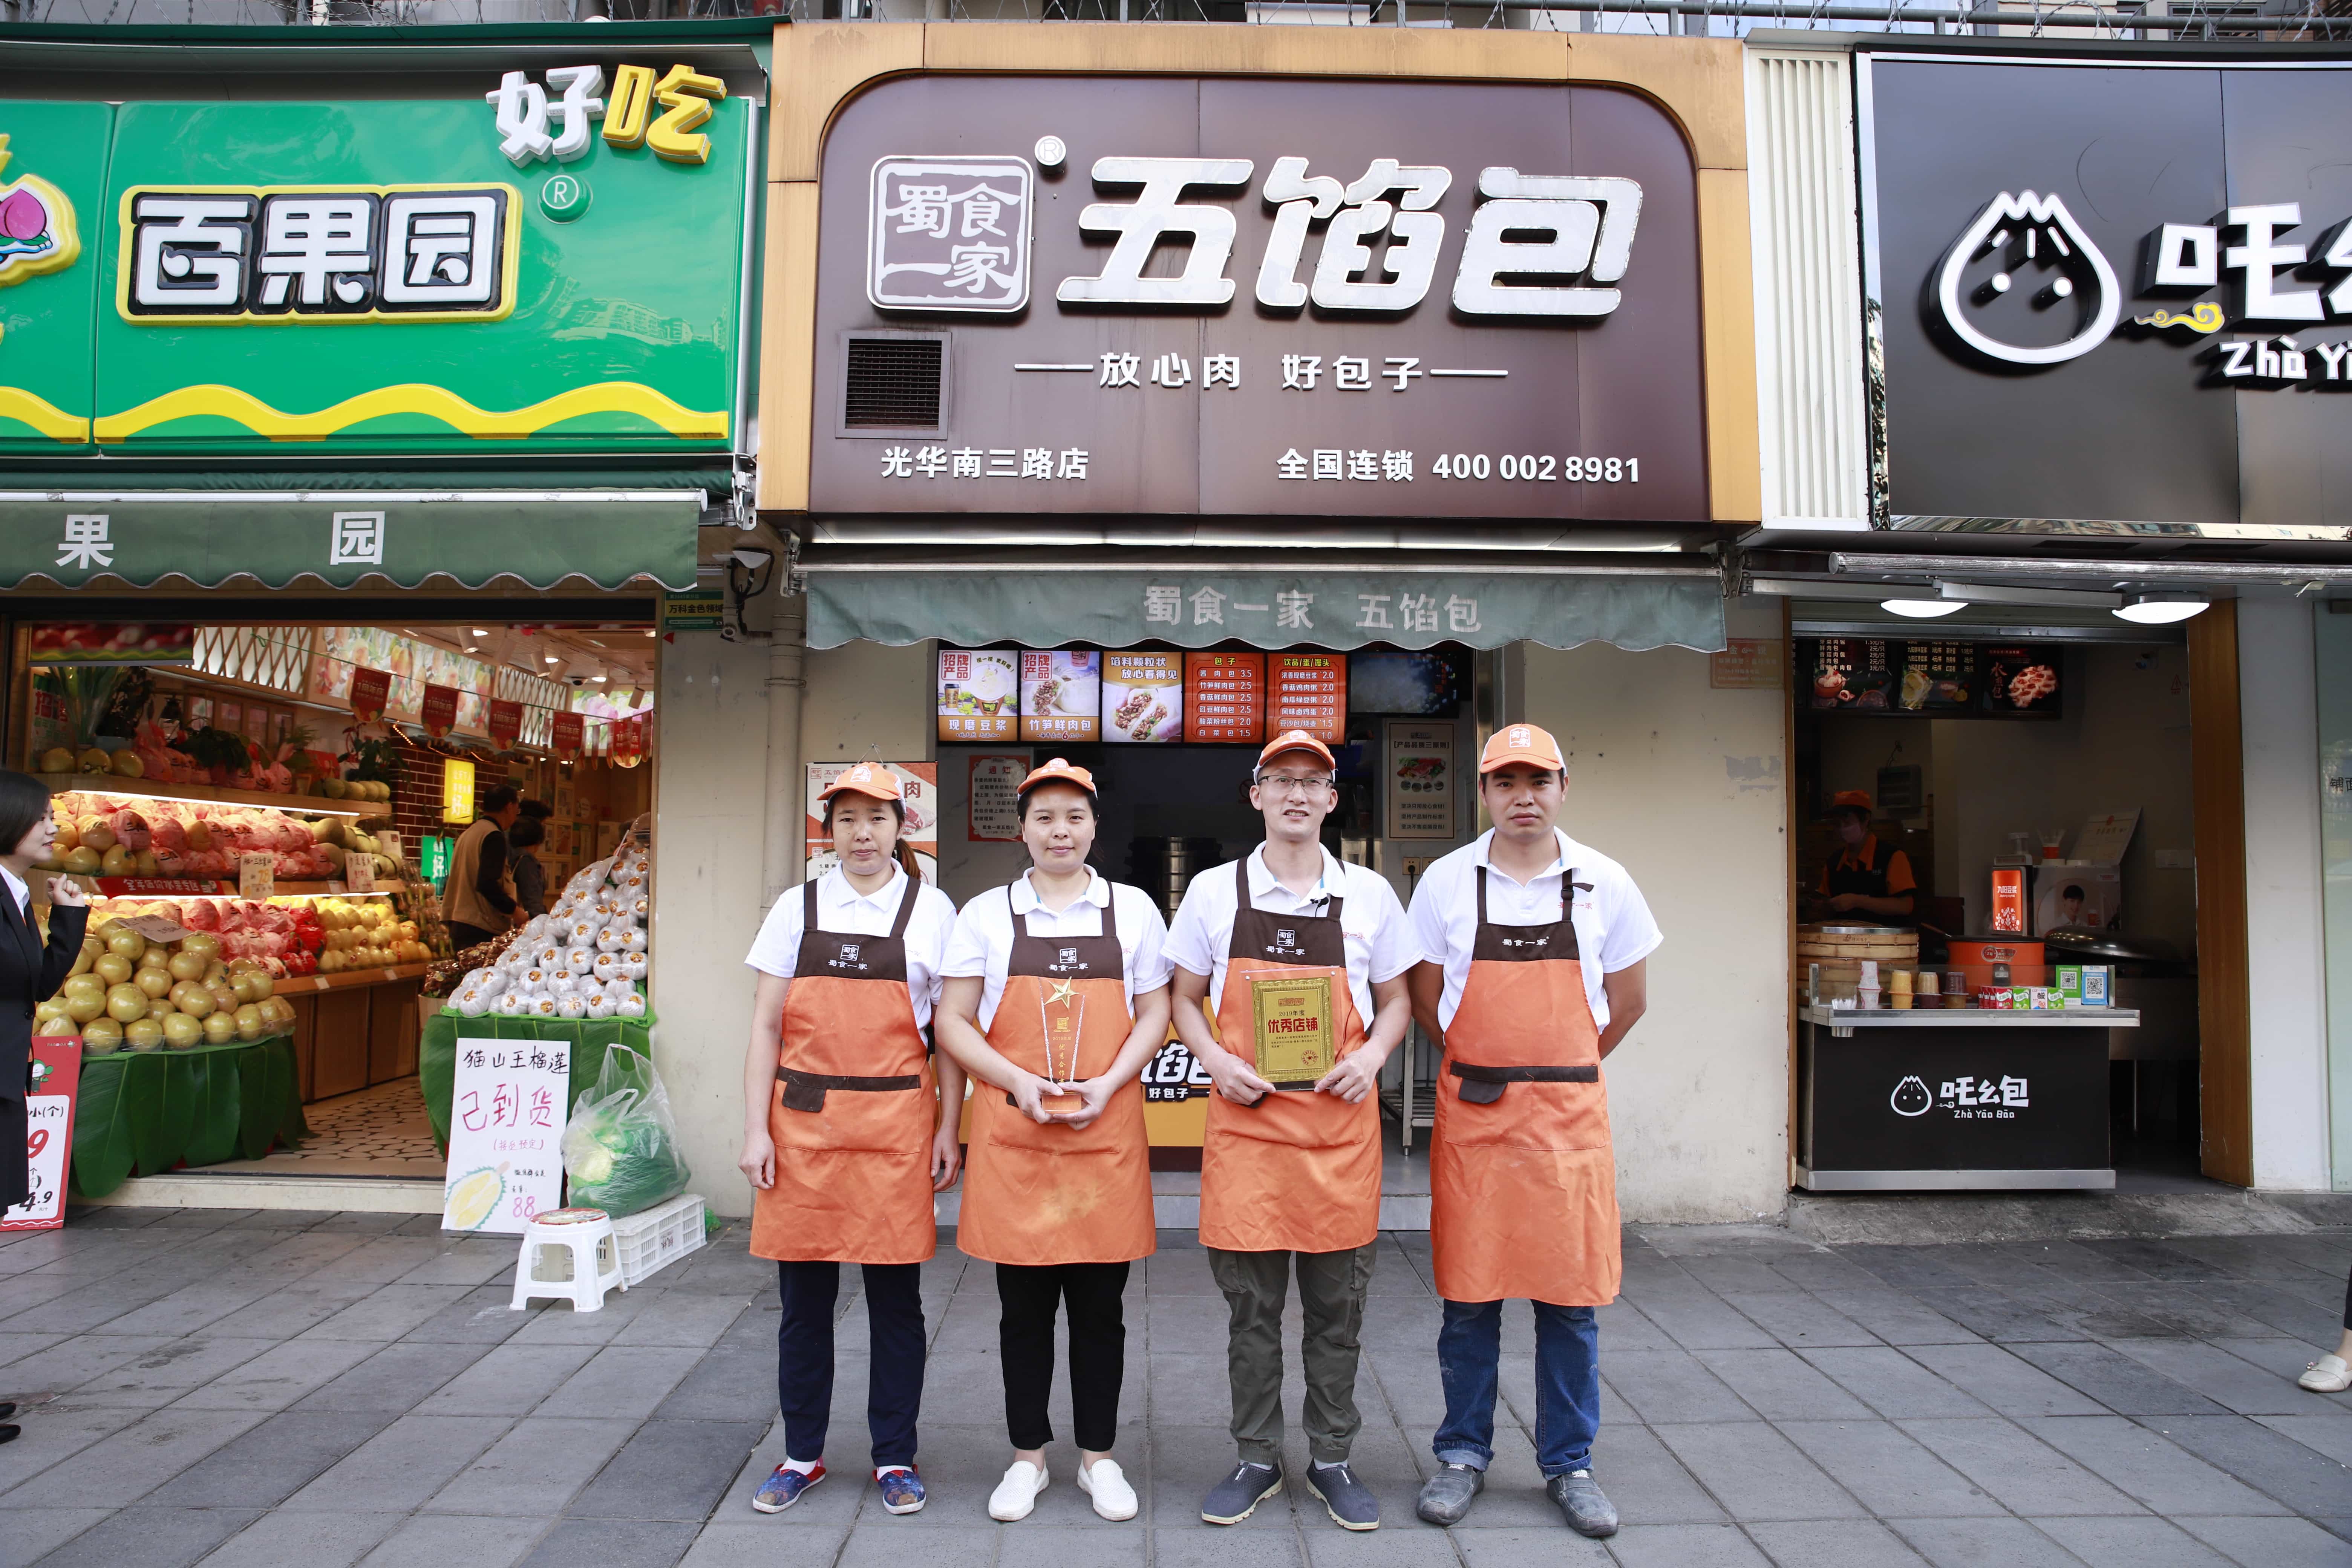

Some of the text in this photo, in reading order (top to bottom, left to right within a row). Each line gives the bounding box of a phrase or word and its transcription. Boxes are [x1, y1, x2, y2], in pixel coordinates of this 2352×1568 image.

[486, 64, 727, 168] 好吃
[1057, 156, 1643, 316] 五馅包
[135, 196, 497, 306] 百果园
[2154, 202, 2352, 321] 吒
[2316, 341, 2352, 380] Y
[1099, 352, 1422, 390] 放心肉 好包子
[881, 446, 1089, 480] 光华南三路店
[1276, 447, 1639, 482] 全国连锁 400 002 8981
[57, 511, 386, 569] 果 园
[1143, 585, 1482, 633] 蜀食一家 五馅包
[943, 654, 969, 666] 招牌
[1024, 654, 1050, 666] 招牌
[1110, 656, 1167, 667] 馅料颗粒状
[1214, 657, 1236, 665] 包子
[1283, 657, 1331, 667] 饮品/蛋/馒头
[943, 666, 969, 678] 产品
[1024, 666, 1050, 678] 产品
[1121, 669, 1178, 680] 放心看得见
[1282, 695, 1317, 704] 南瓜绿豆粥
[948, 719, 1006, 731] 现磨豆浆
[1029, 719, 1092, 731] 竹笋鲜肉包
[1279, 719, 1317, 728] 豆沙包/烧麦
[1997, 885, 2017, 894] 九阳豆浆
[1502, 938, 1547, 946] 蜀食一家
[1265, 945, 1306, 956] 蜀食一家
[828, 959, 868, 970] 蜀食一家
[1048, 963, 1089, 972] 蜀食一家
[1267, 1017, 1318, 1034] 优秀店铺
[463, 1046, 569, 1074] 猫山王榴莲
[1148, 1088, 1188, 1099] 好包子
[512, 1195, 536, 1218] 88
